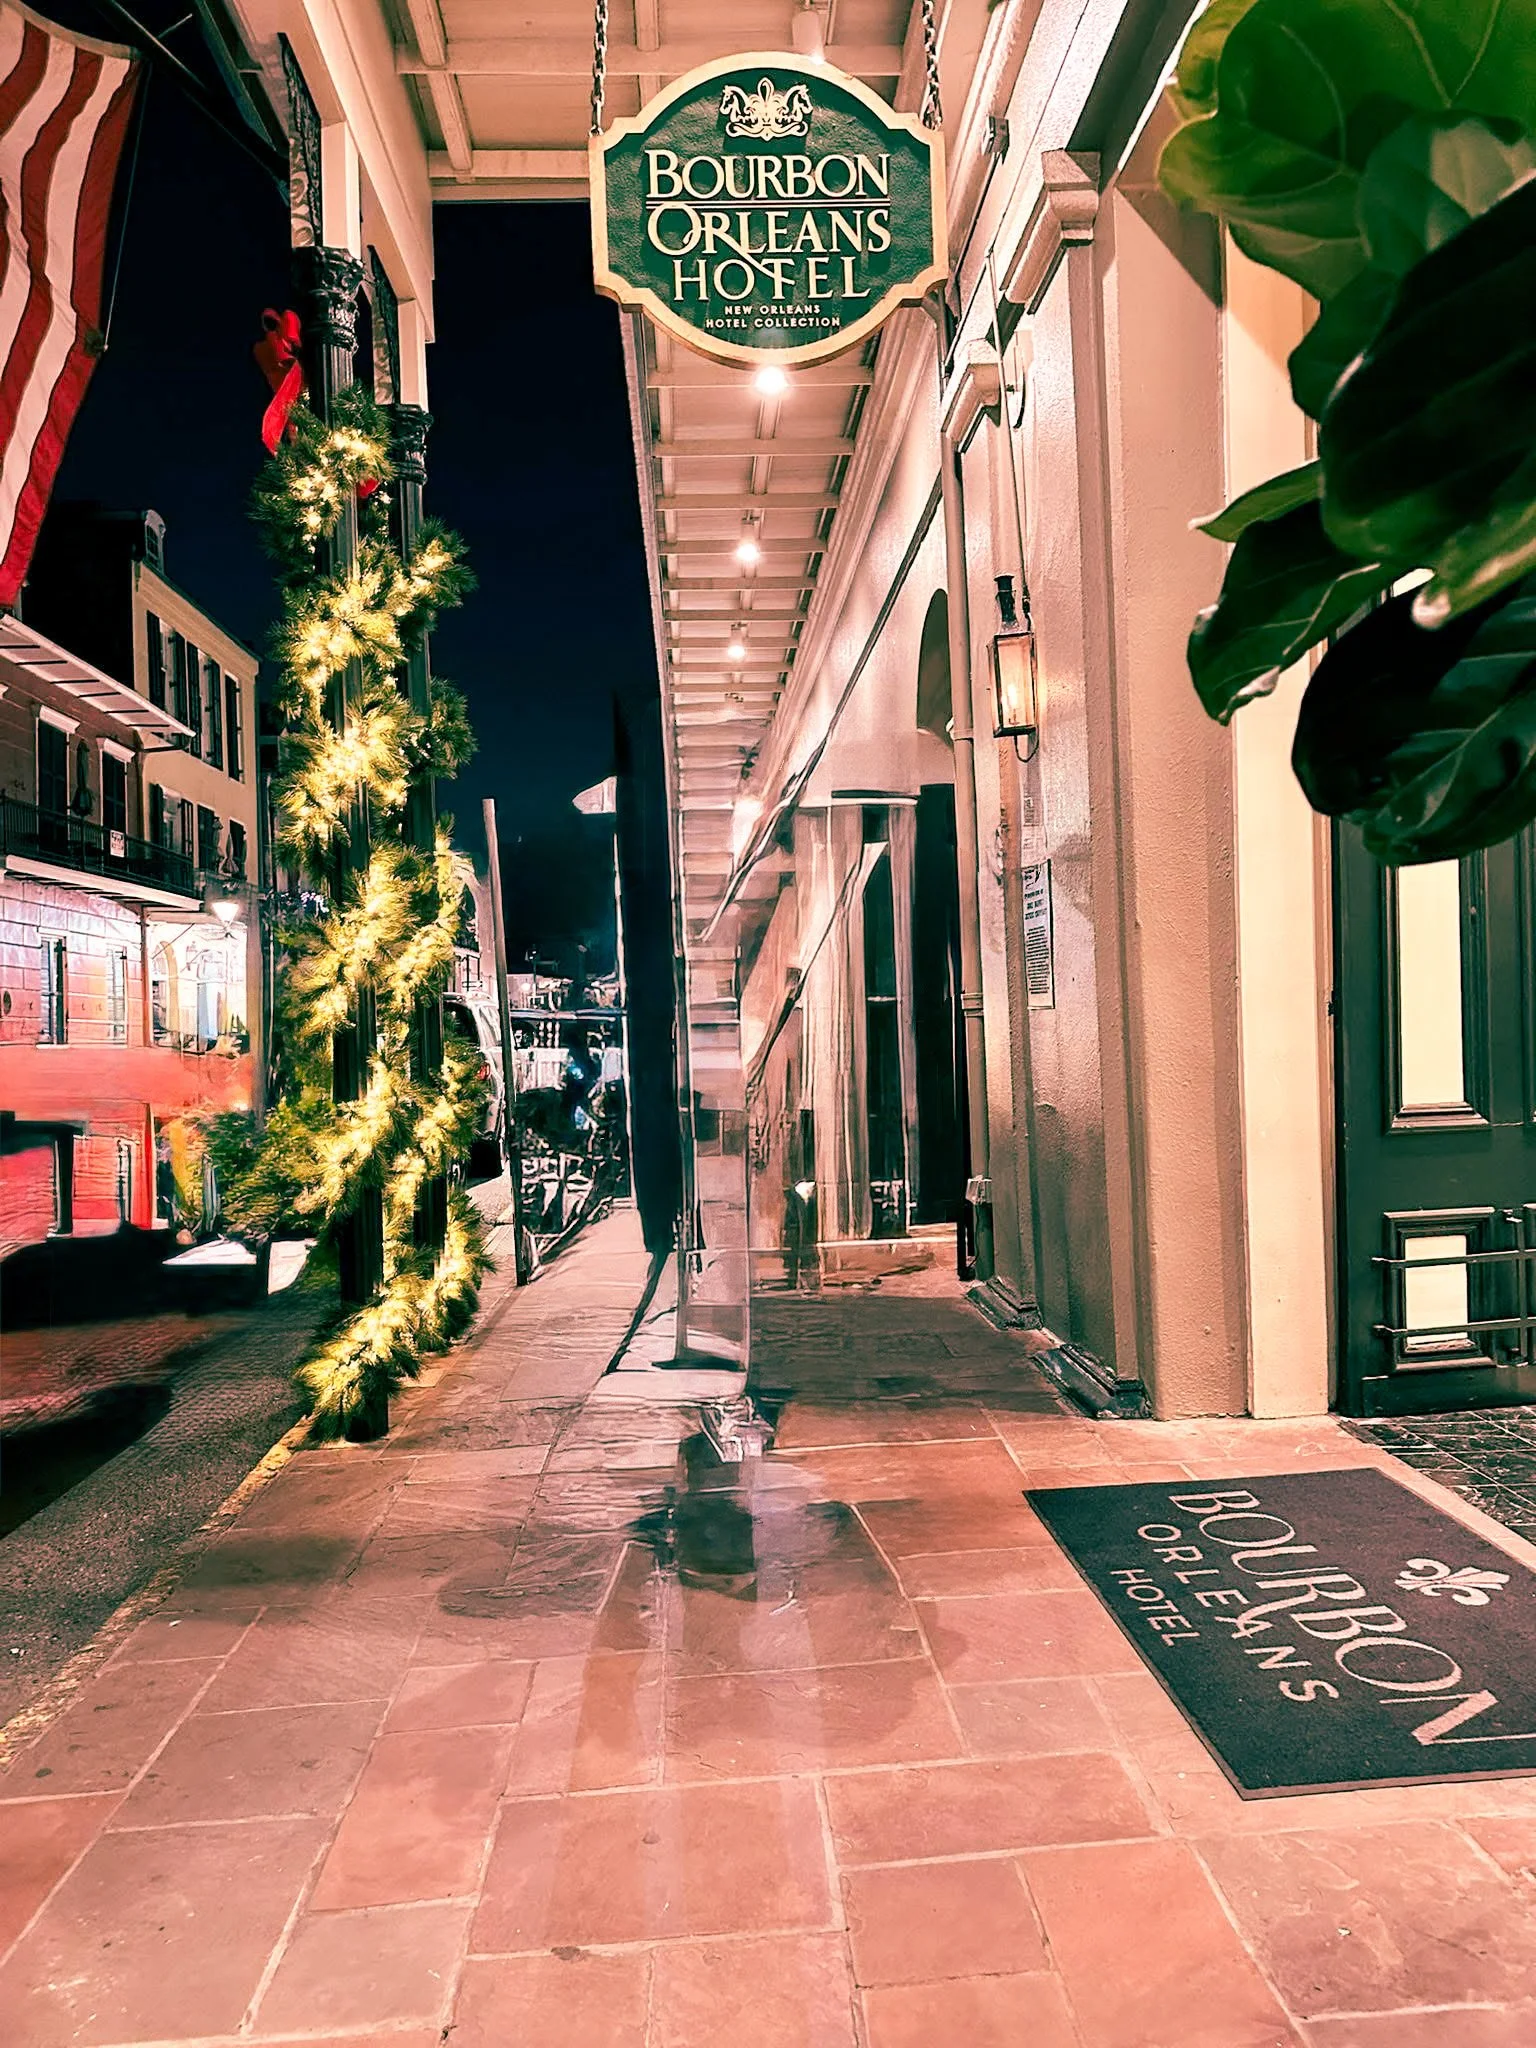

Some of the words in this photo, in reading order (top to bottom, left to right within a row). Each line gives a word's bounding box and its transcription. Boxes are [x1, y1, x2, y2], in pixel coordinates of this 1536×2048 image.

[645, 149, 890, 199] BOURBON
[647, 202, 892, 256] ORLEANS
[673, 256, 871, 300] HOTEL
[705, 318, 748, 328] HOTEL
[754, 317, 840, 328] COLLECTION
[724, 305, 753, 315] NEW
[759, 304, 821, 315] ORLEANS
[1111, 1568, 1200, 1646] HOTEL
[1137, 1523, 1340, 1702] ORLEANS
[1169, 1490, 1536, 1746] BOURBON
